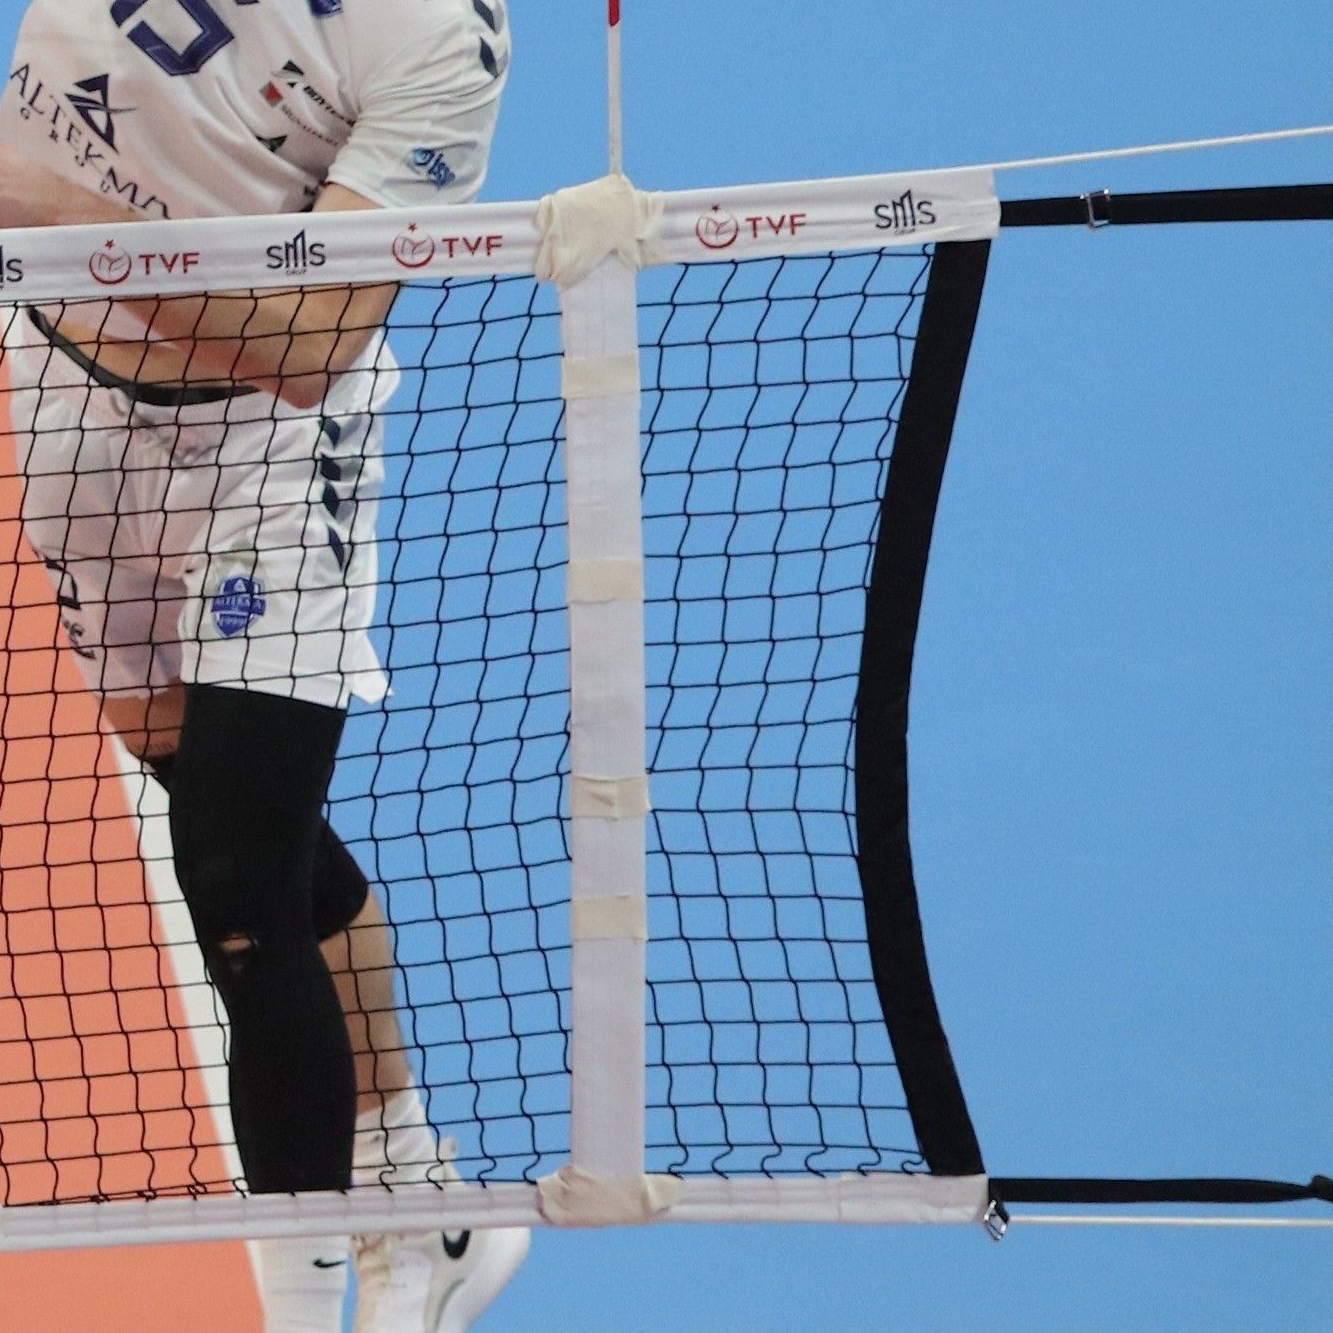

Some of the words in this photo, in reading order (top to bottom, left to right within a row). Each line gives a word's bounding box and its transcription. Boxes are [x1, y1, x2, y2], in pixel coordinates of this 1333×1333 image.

[874, 189, 936, 229] SMS
[745, 214, 807, 238] TVF
[266, 230, 326, 269] SMS
[442, 235, 503, 258] TVF
[139, 252, 199, 276] TVF
